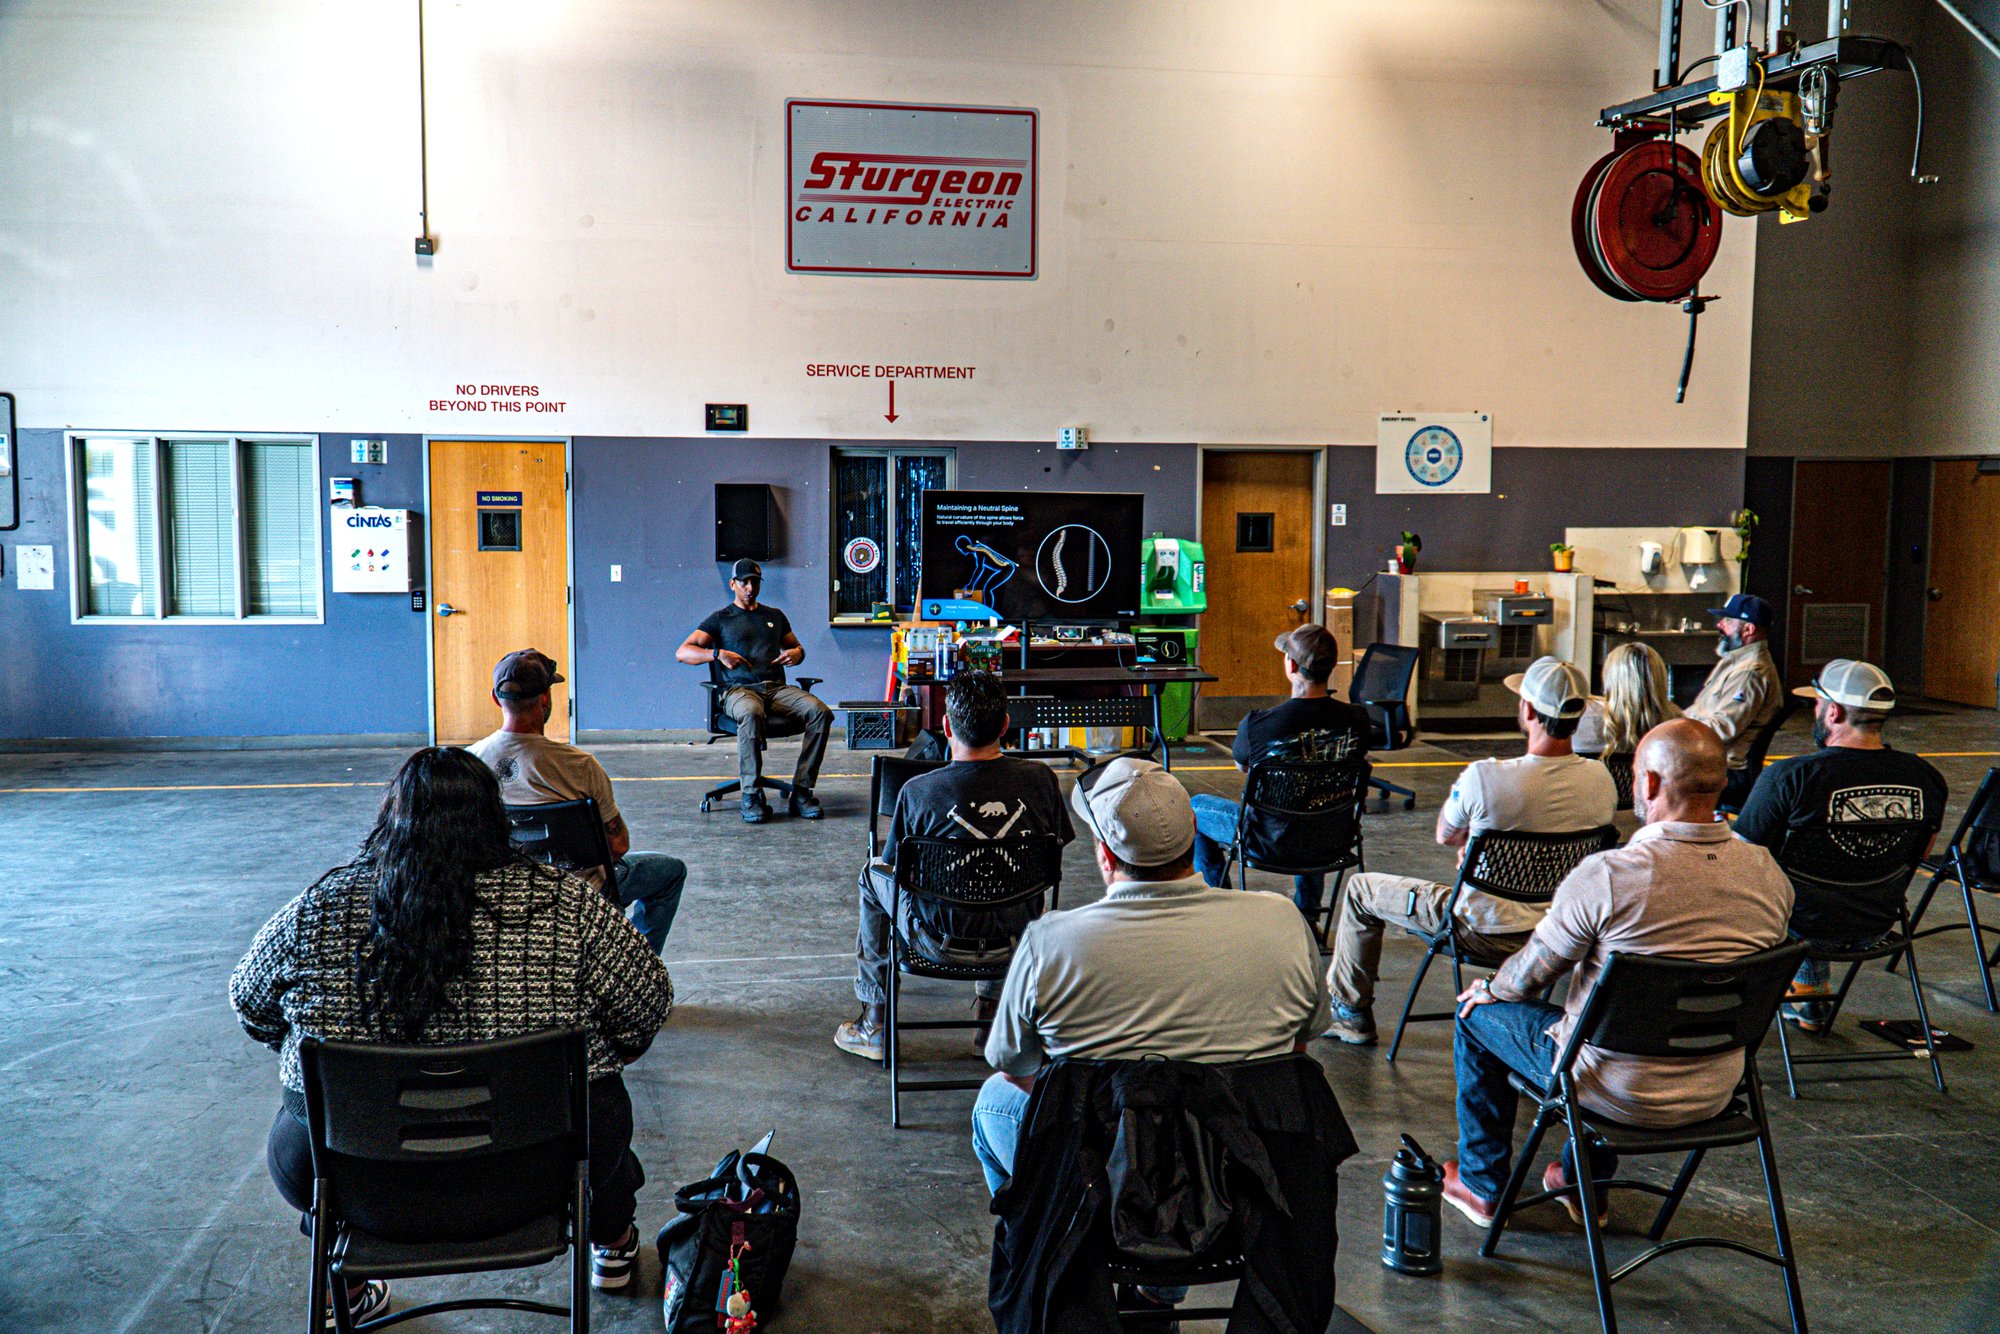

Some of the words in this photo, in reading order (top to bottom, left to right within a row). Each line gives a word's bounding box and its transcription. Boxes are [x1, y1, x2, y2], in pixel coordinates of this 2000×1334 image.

[803, 152, 1023, 205] Sturgeon
[933, 197, 1014, 210] ELECTRIC
[795, 206, 1009, 229] CALIFORNIA
[806, 363, 870, 378] SERVICE
[875, 365, 976, 380] DEPARTMENT
[456, 384, 476, 396] NO
[481, 385, 539, 397] DRIVERS
[429, 400, 487, 412] BEYOND
[491, 401, 521, 413] THIS
[526, 402, 566, 413] POINT
[936, 504, 972, 512] Maintaining
